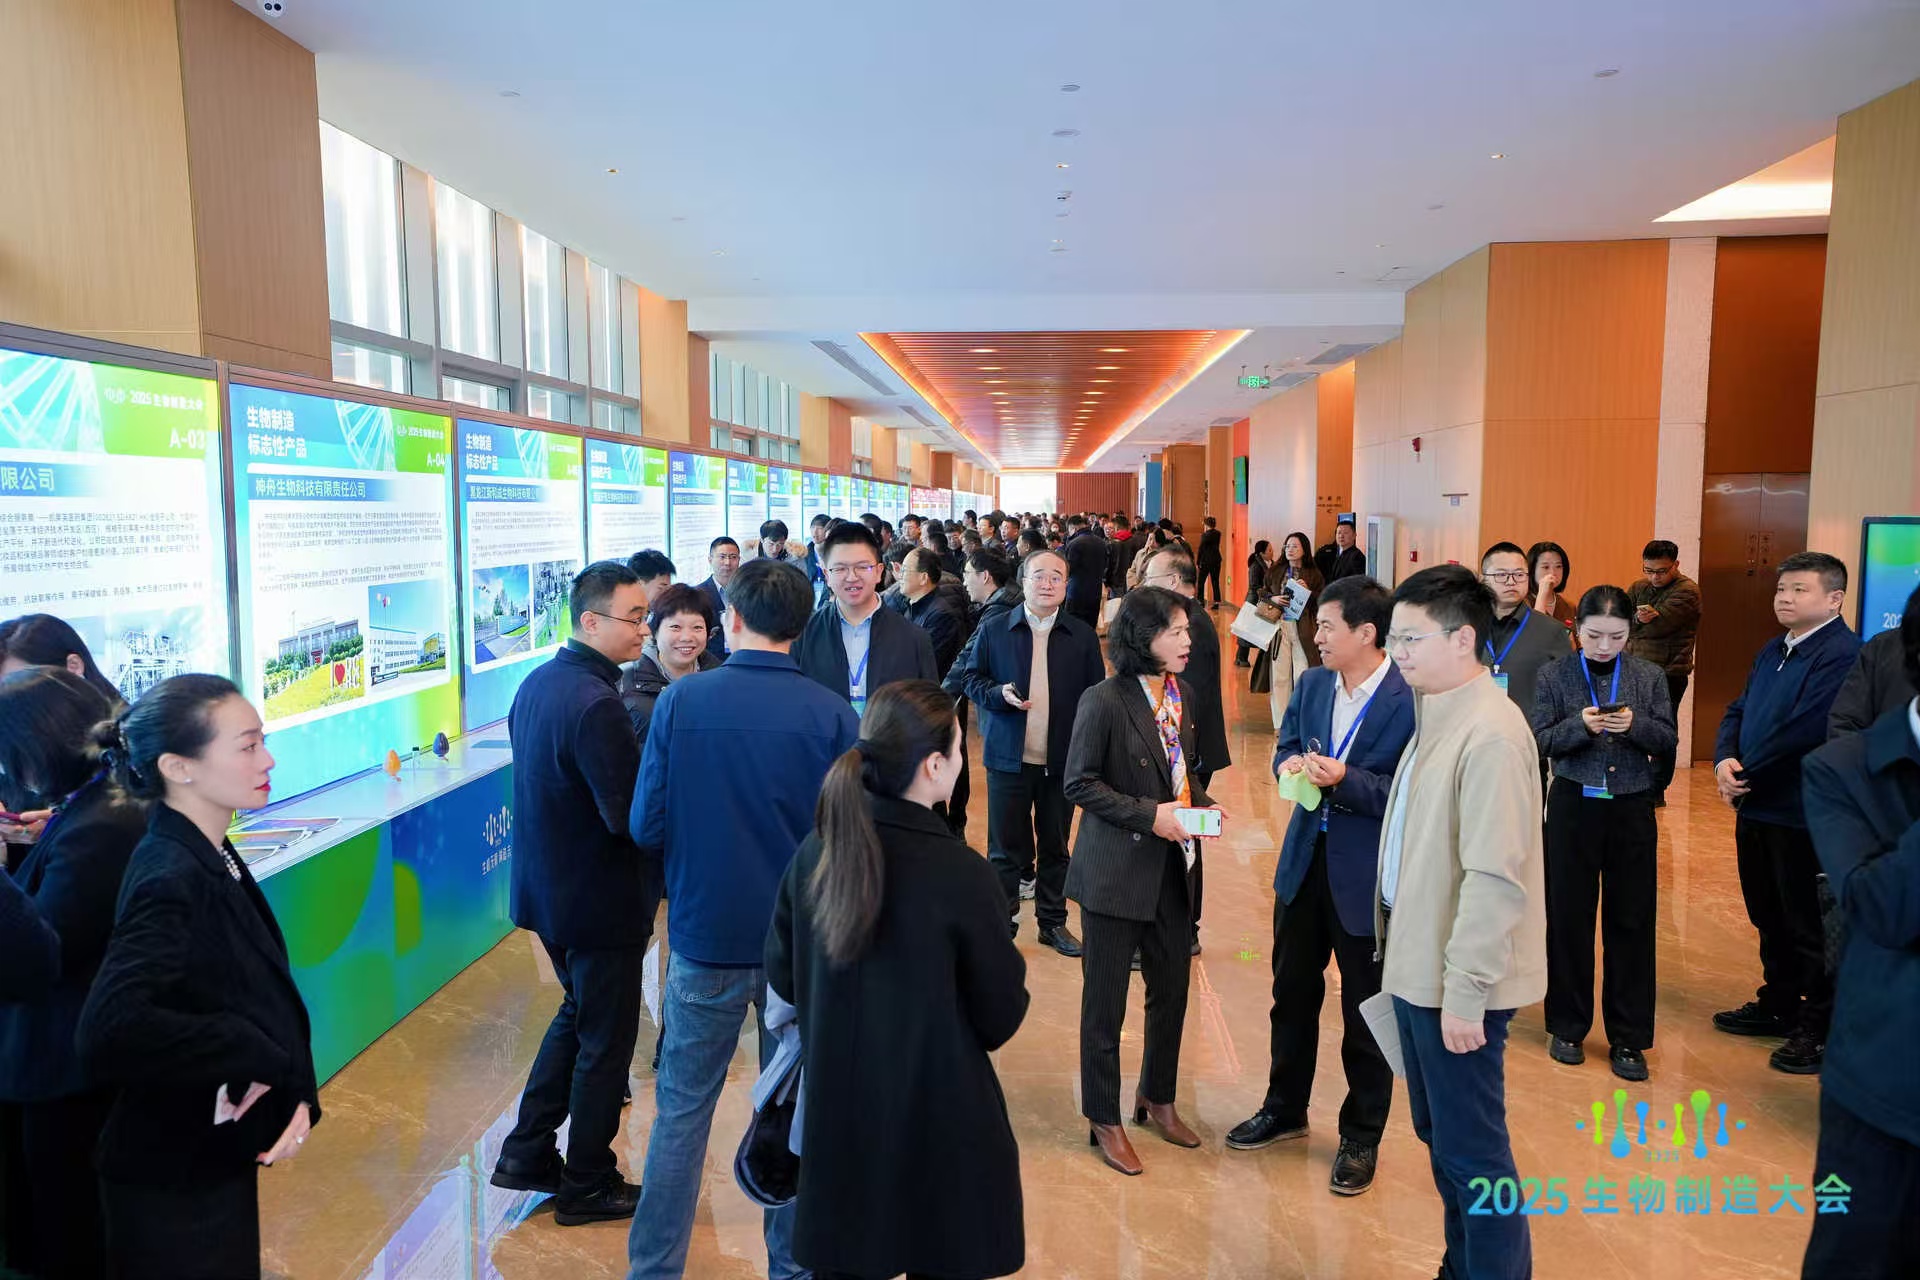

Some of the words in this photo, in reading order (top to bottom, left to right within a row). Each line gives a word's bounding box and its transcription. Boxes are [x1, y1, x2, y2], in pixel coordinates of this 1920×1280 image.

[246, 405, 295, 432] 生物制造
[247, 433, 307, 458] 标志性产品
[255, 478, 366, 498] 神舟生物科技有限责任公司
